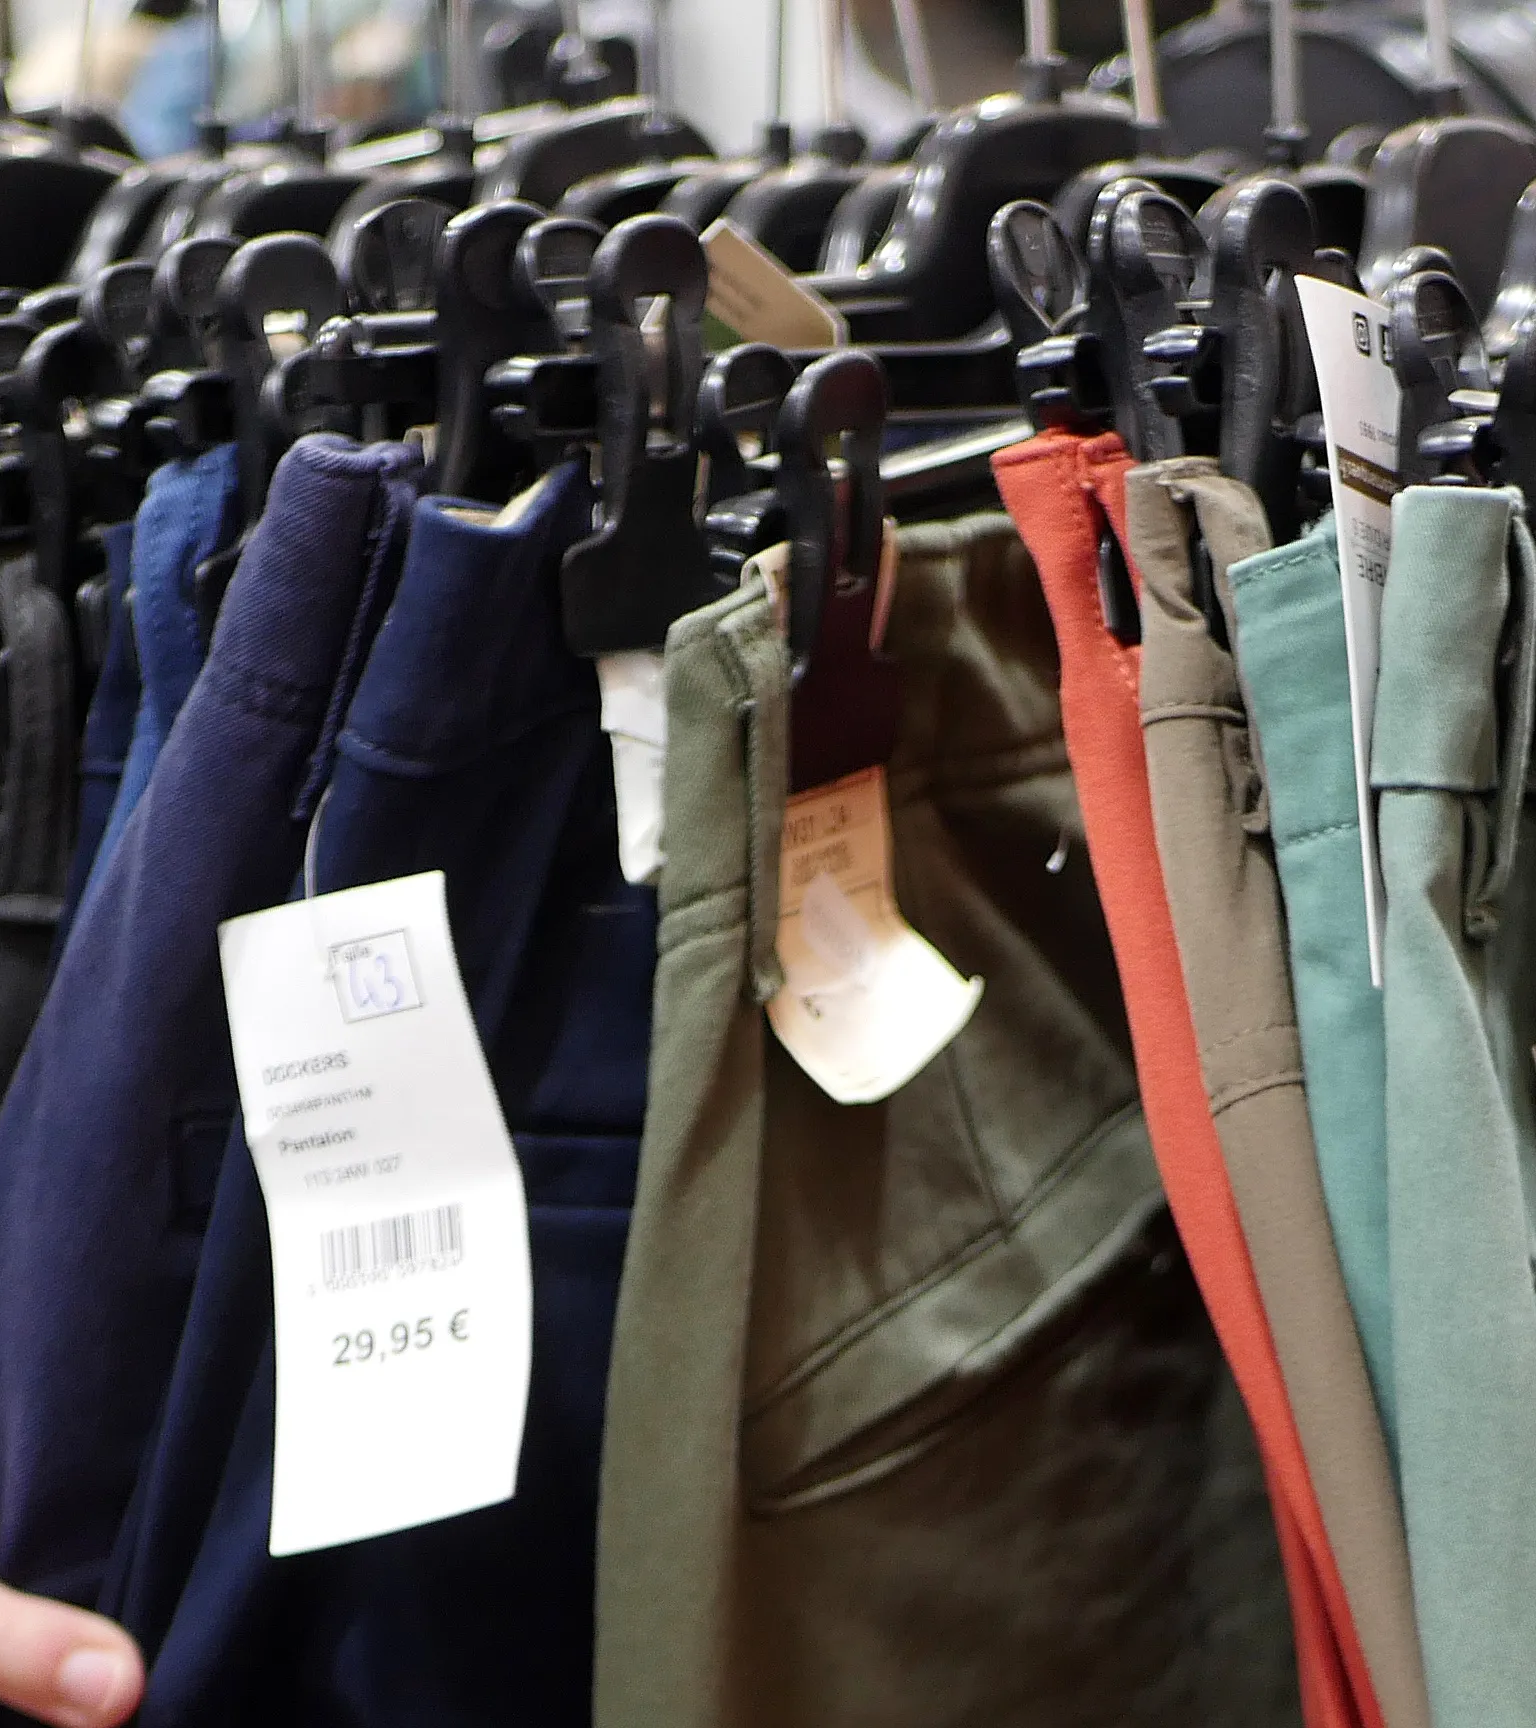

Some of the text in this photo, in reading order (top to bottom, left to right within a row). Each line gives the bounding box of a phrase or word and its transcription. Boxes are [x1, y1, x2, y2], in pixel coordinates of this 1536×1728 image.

[262, 1050, 351, 1086] DOCKERS
[278, 1128, 358, 1157] Pantalon
[332, 1307, 471, 1369] 29,95 €
